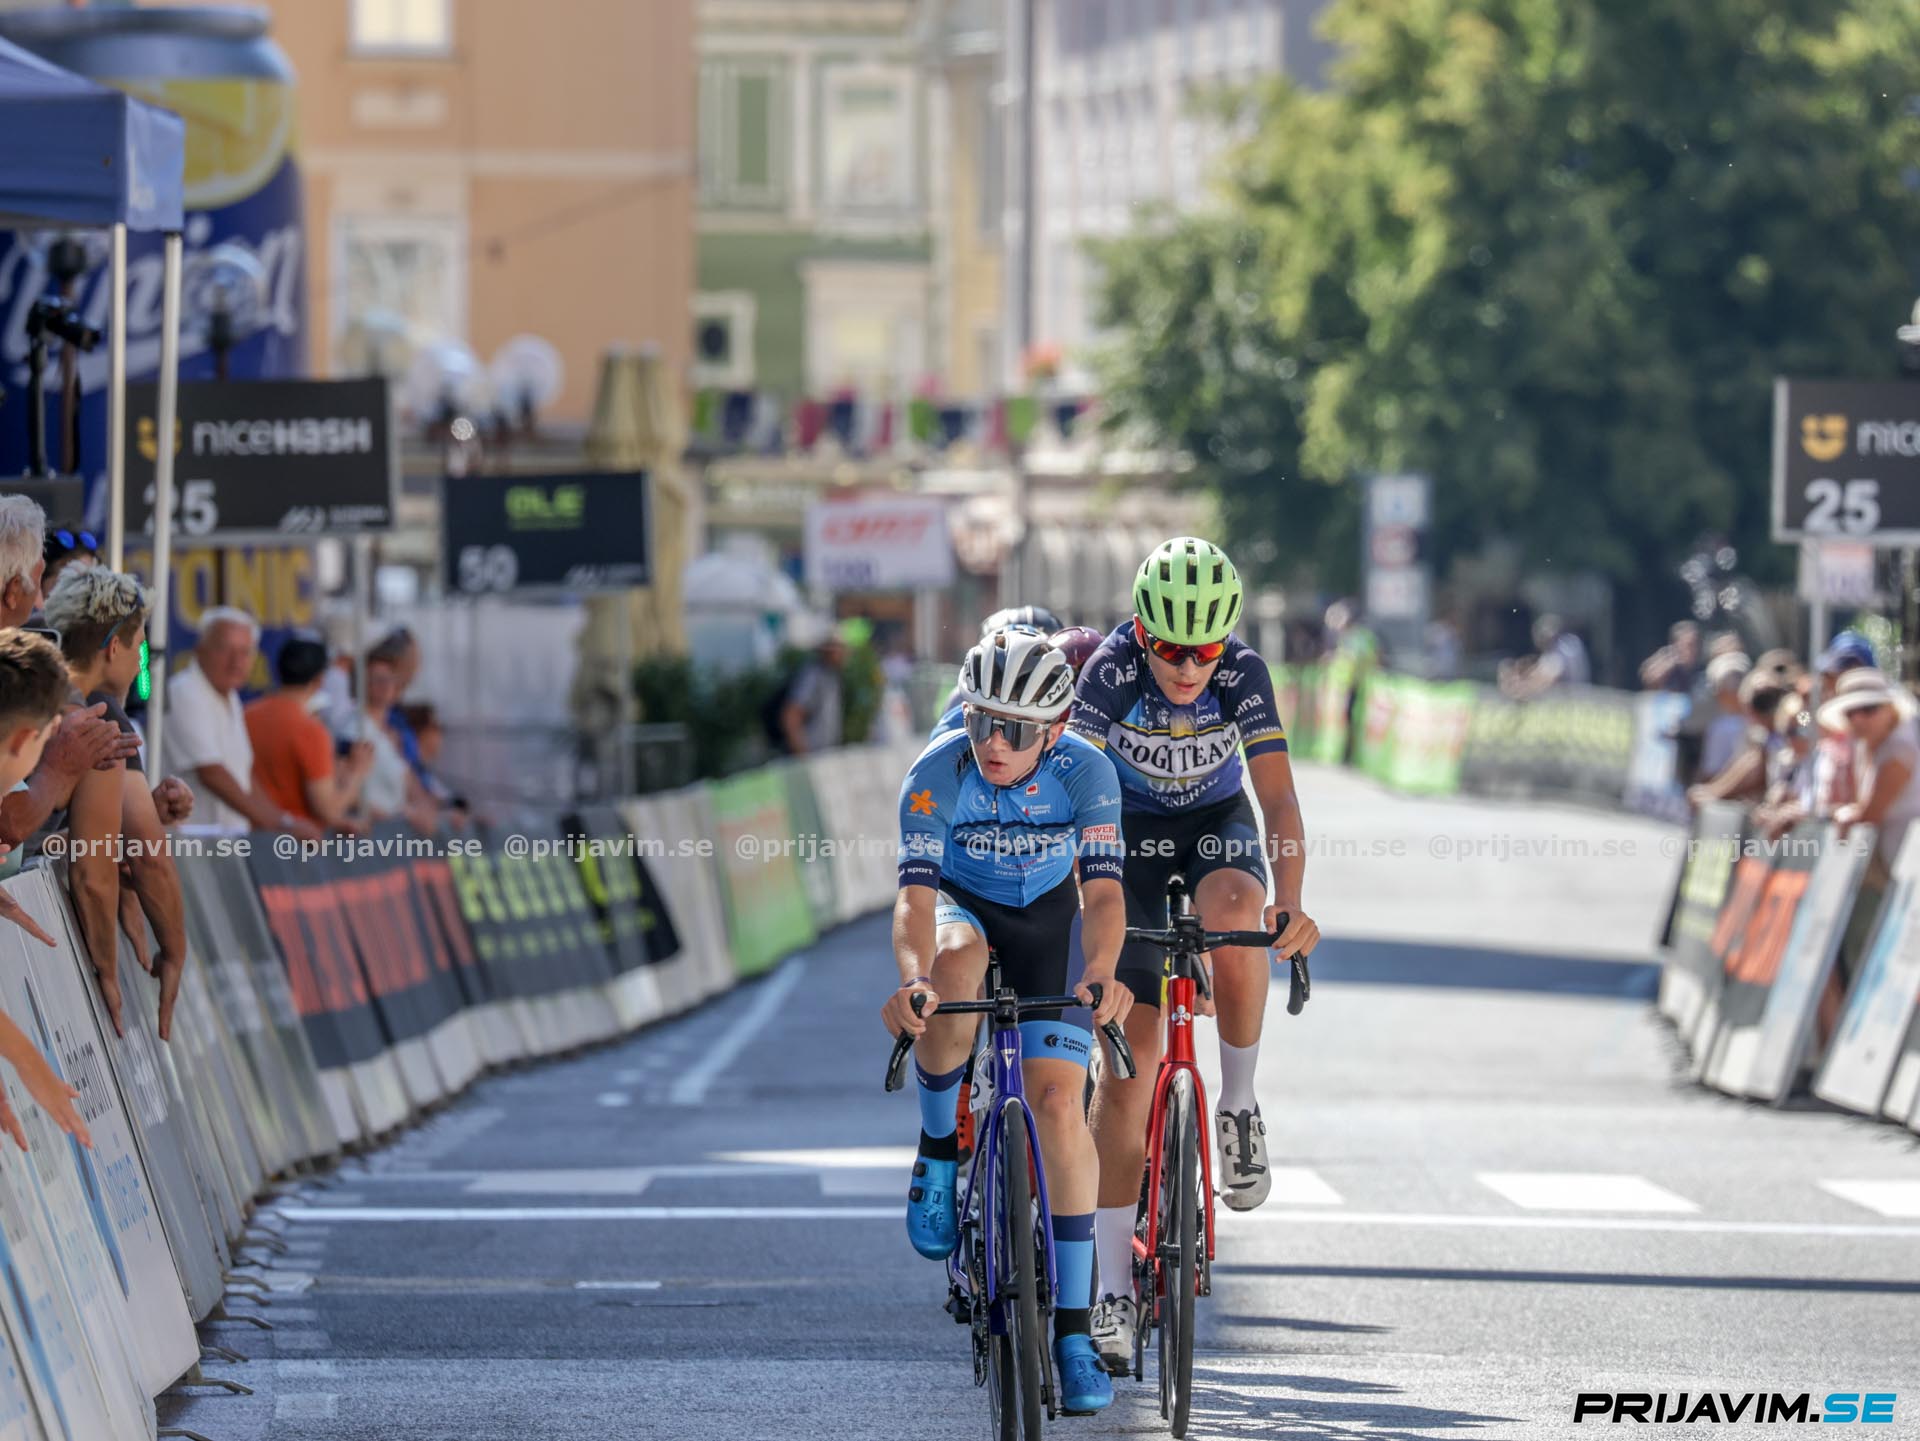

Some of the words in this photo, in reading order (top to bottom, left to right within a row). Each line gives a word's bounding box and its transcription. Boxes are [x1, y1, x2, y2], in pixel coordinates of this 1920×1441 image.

[1804, 478, 1881, 535] 25
[458, 544, 518, 592] 50
[907, 867, 933, 876] sport
[1063, 1043, 1087, 1056] sport
